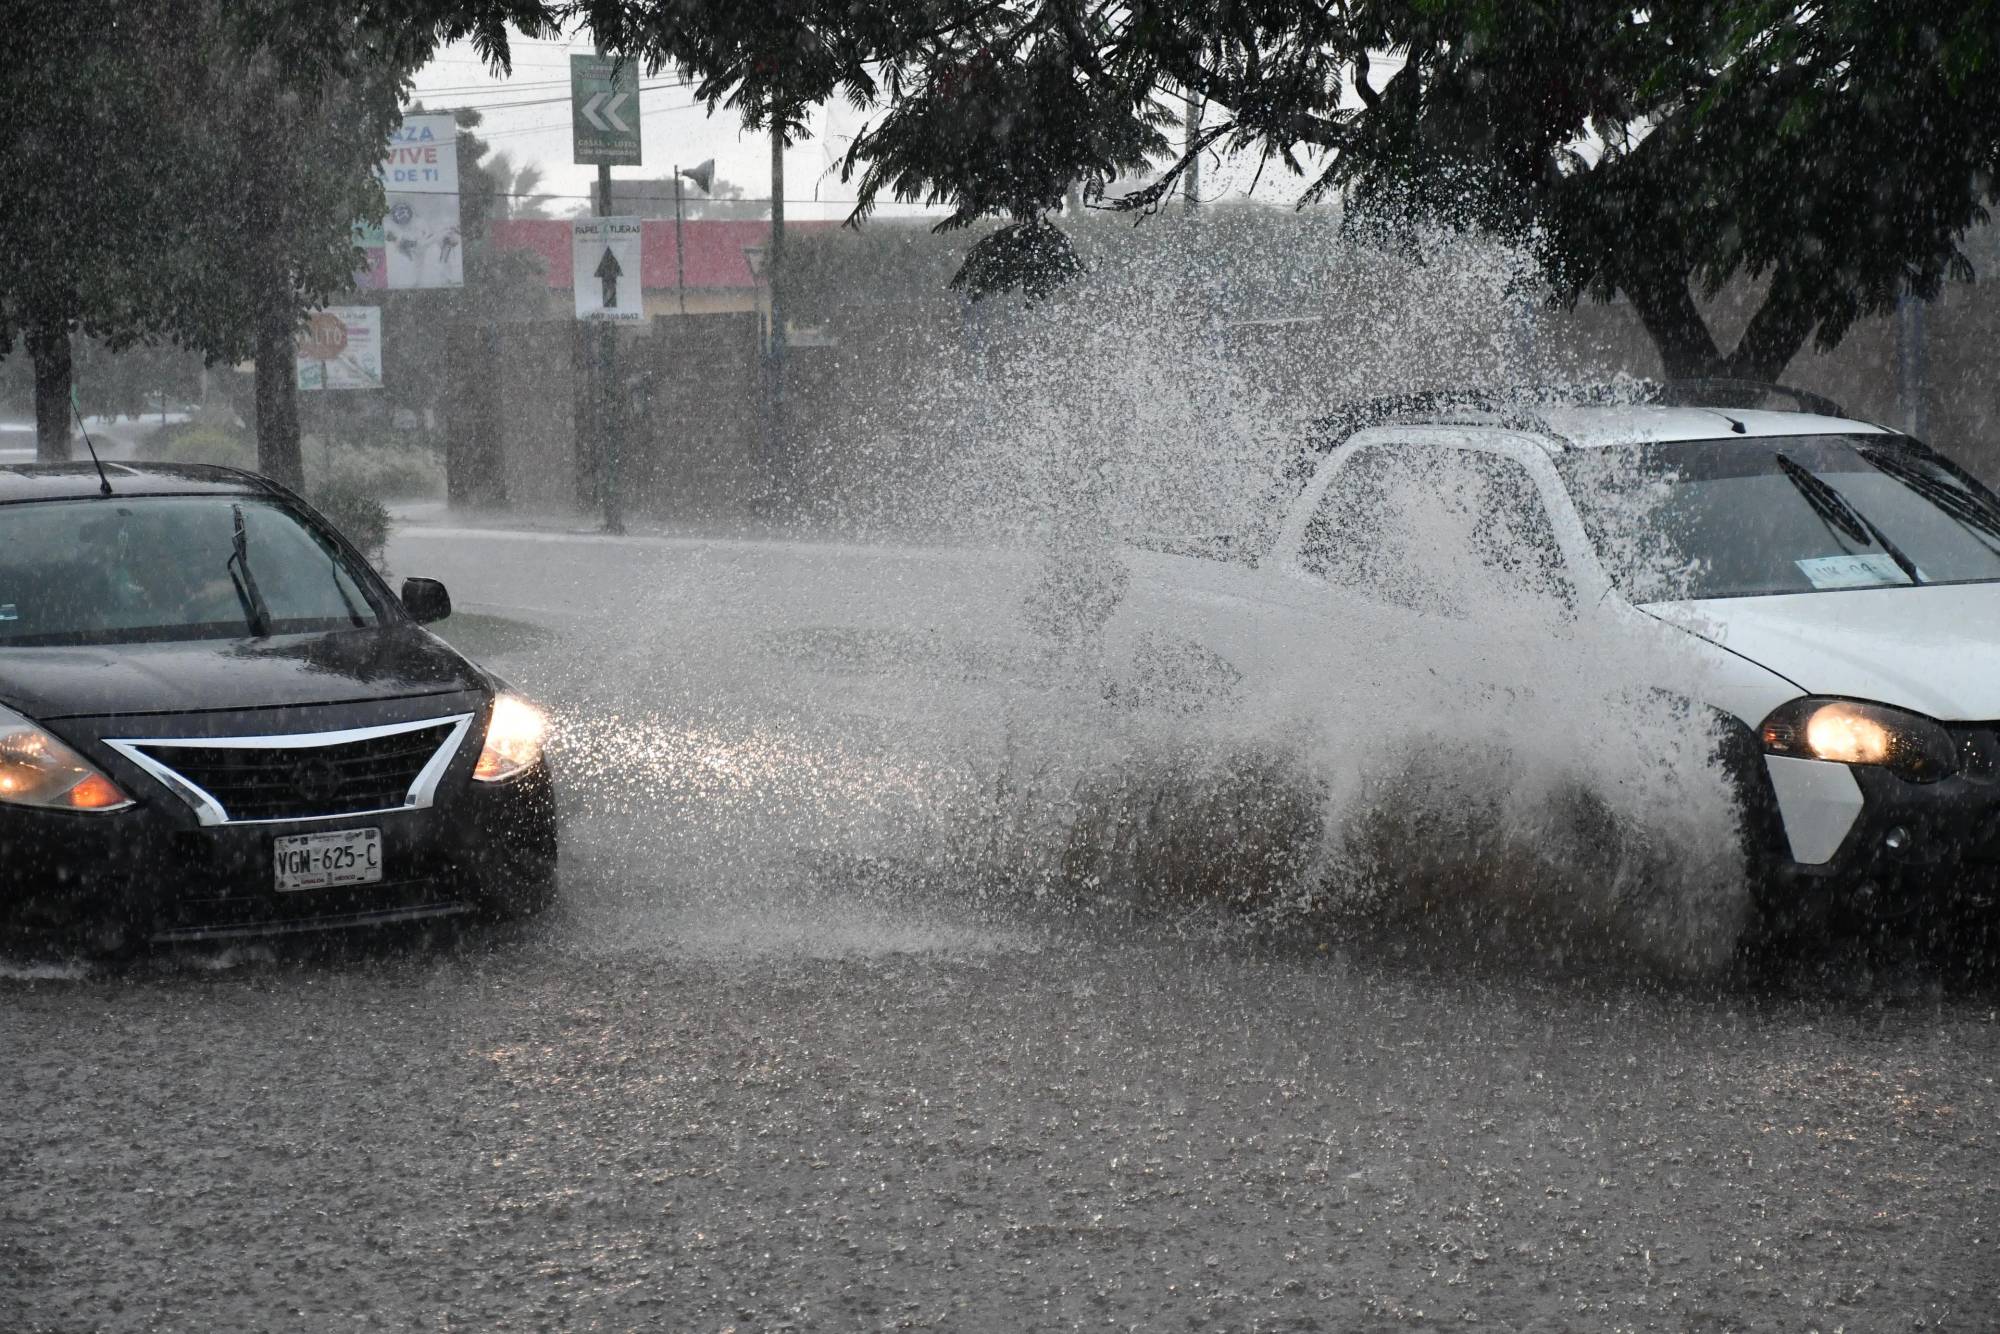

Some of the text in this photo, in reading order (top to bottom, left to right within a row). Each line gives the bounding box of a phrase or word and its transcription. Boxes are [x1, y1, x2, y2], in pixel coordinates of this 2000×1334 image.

[395, 169, 417, 181] DE
[422, 168, 438, 181] TI
[575, 224, 640, 234] PAPEL TIJERAS
